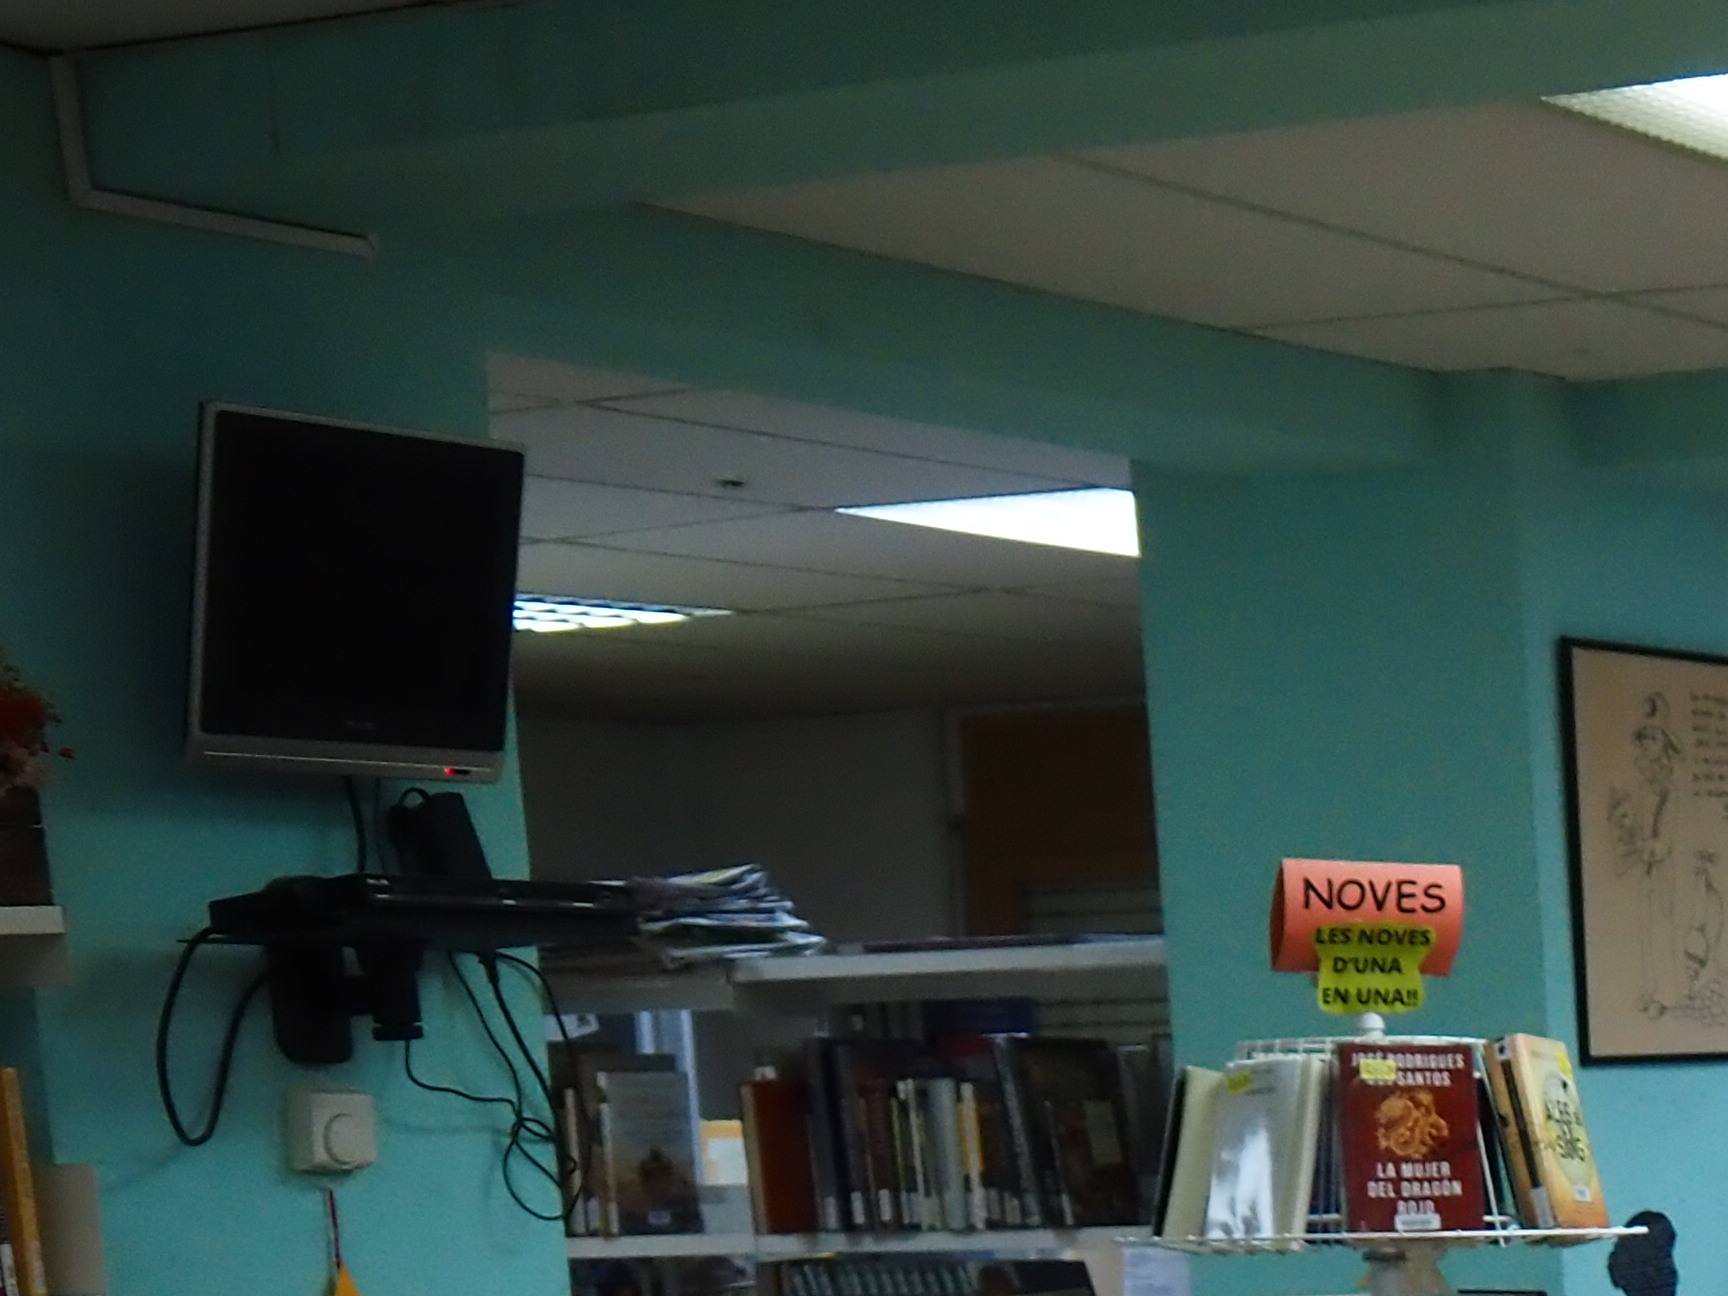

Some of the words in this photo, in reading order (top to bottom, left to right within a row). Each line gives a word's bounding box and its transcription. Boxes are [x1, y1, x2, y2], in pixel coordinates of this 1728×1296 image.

[1303, 877, 1446, 914] NOVES
[1315, 927, 1352, 945] LES
[1357, 928, 1432, 946] NOVES
[1333, 956, 1404, 974] D'UNA
[1322, 986, 1349, 1005] EN
[1397, 1070, 1452, 1087] SANTOS
[1376, 1162, 1397, 1179] LA
[1400, 1160, 1452, 1178] MUJER
[1367, 1180, 1397, 1199] DEL
